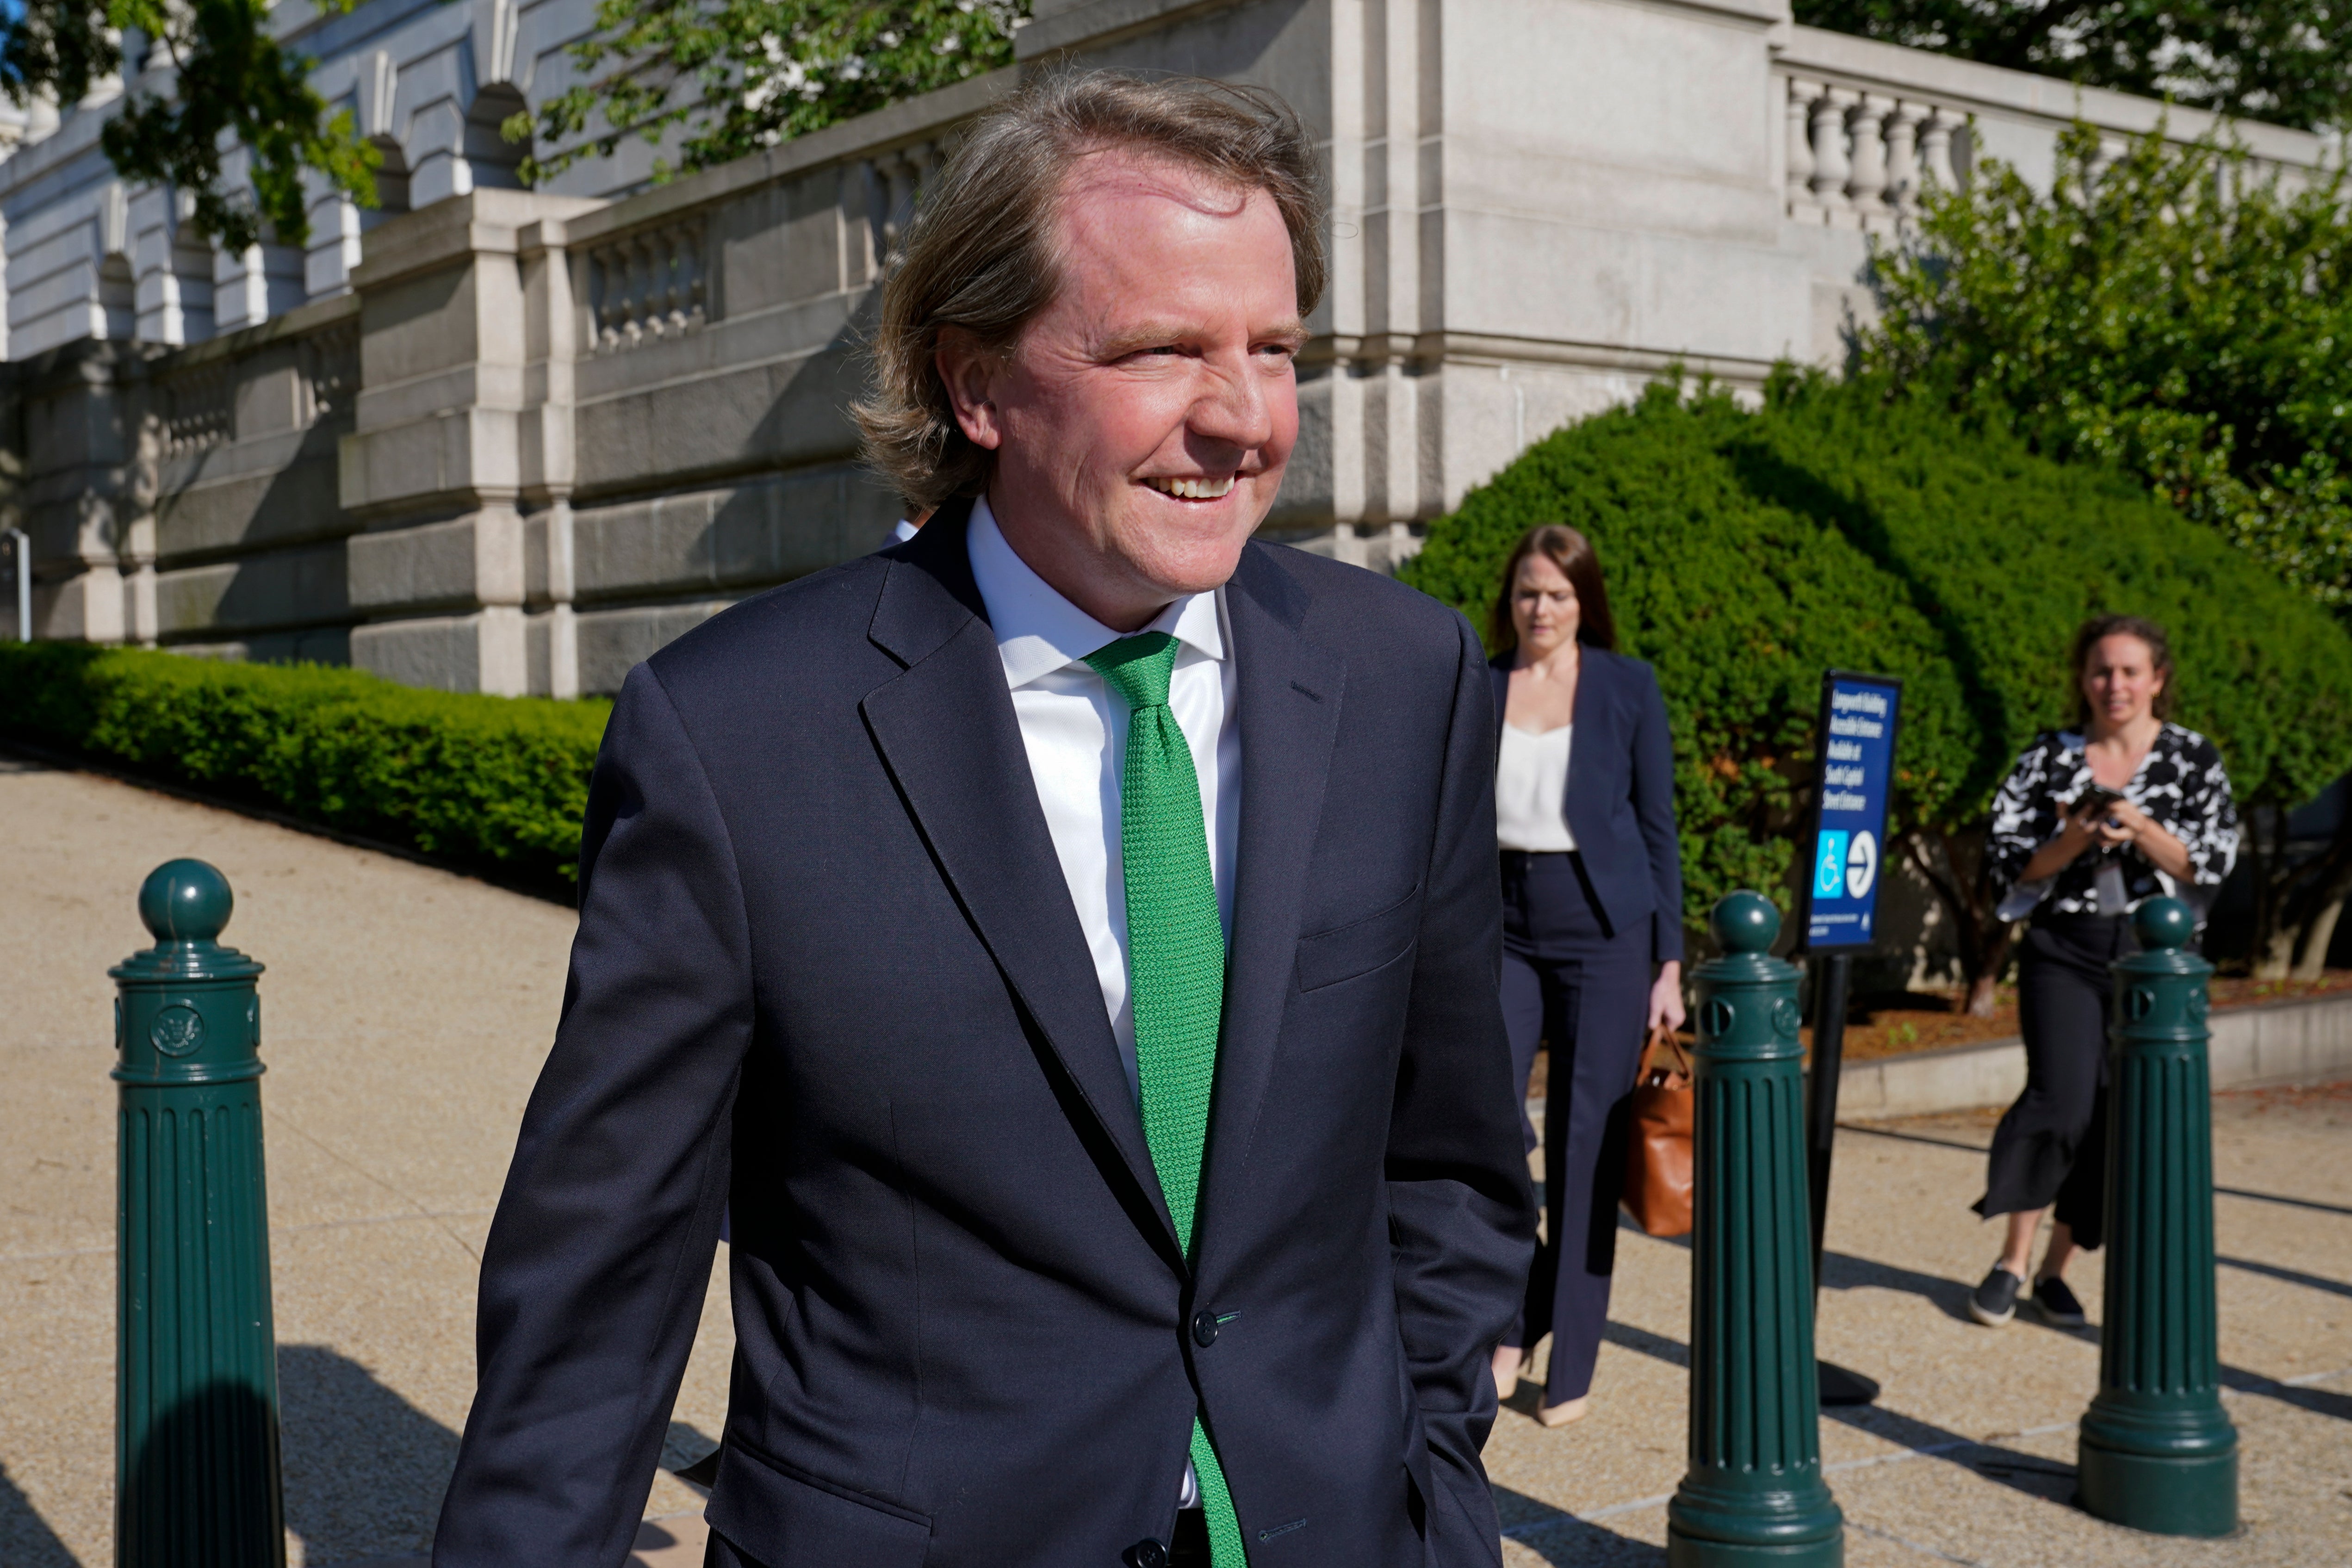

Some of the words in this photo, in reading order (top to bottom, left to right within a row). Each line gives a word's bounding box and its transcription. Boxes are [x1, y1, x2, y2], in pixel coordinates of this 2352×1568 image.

[1832, 689, 1862, 713] Longworth
[1862, 693, 1887, 718] Building
[1829, 715, 1857, 736] Accessible
[1857, 717, 1883, 738] Entrance
[1827, 740, 1853, 760] Available
[1853, 744, 1862, 761] at
[1825, 764, 1843, 785] South
[1843, 766, 1865, 788] Capitol
[1822, 789, 1840, 810] Street
[1840, 790, 1866, 811] Entrance
